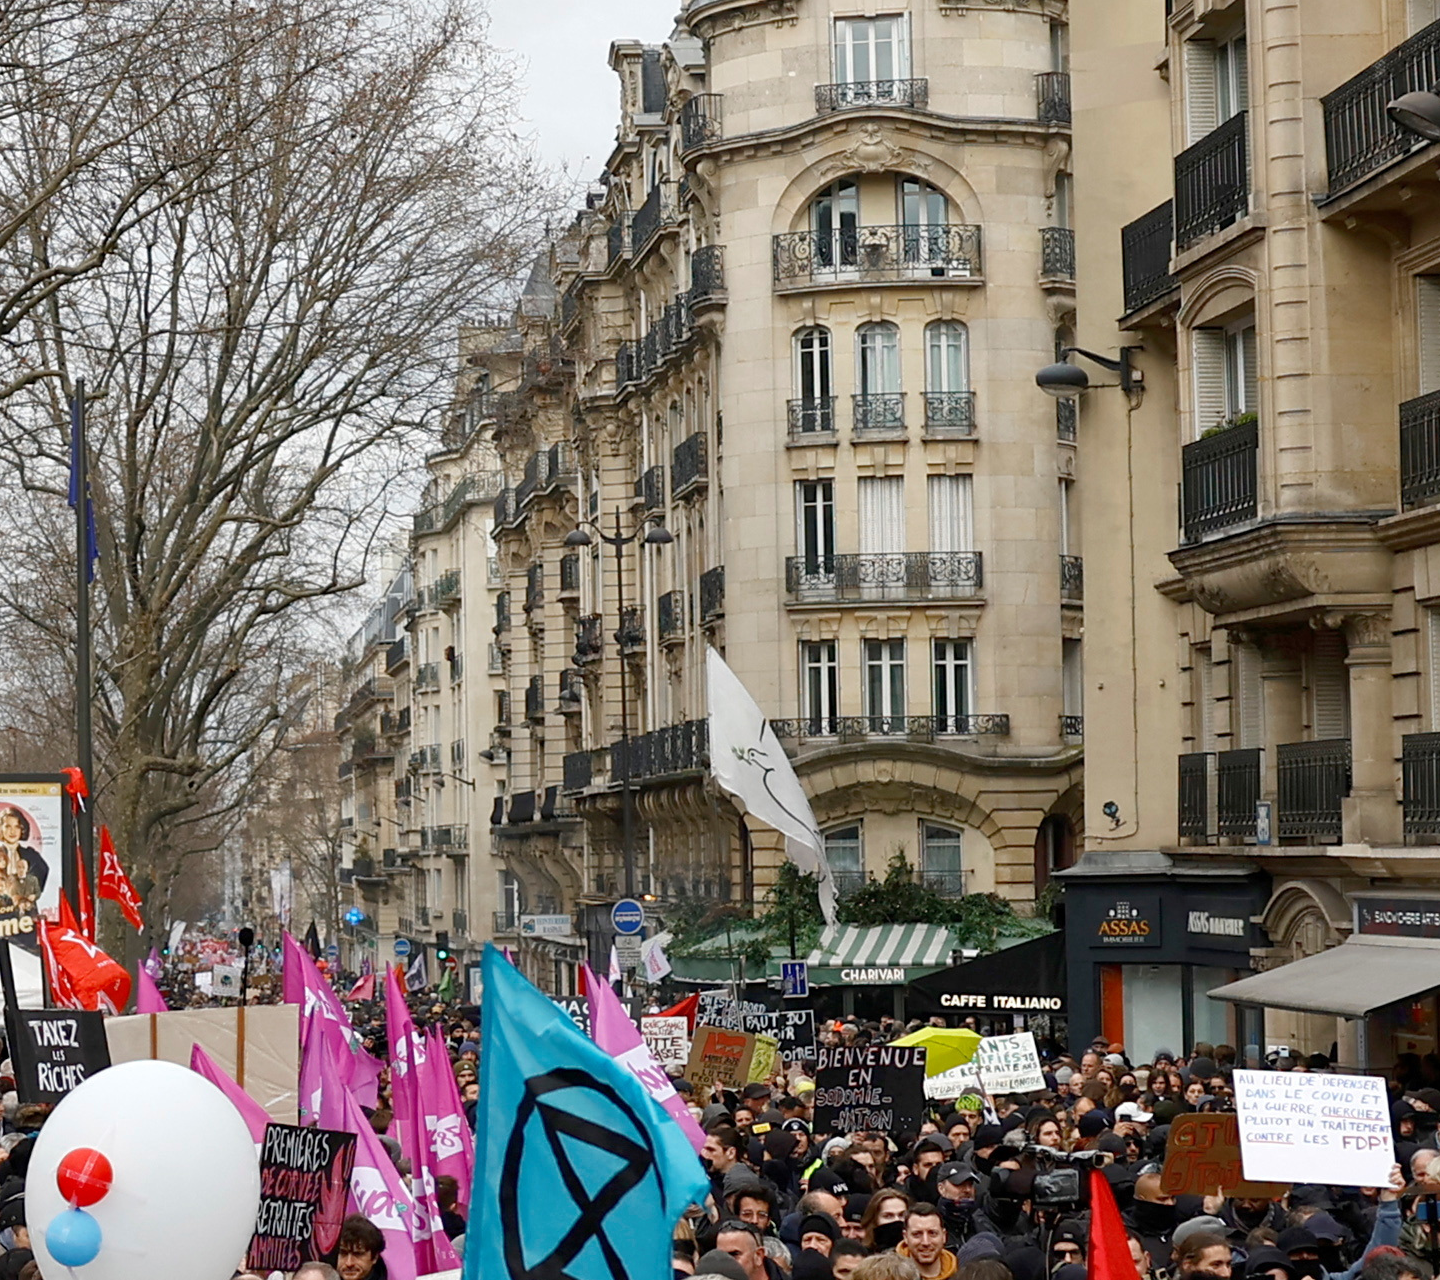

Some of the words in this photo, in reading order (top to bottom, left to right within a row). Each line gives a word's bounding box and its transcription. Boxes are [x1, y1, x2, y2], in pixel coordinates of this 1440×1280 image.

[1098, 920, 1150, 935] ASSAS
[841, 968, 905, 981] CHARIVARI
[940, 994, 986, 1007] CAFFE
[993, 996, 1062, 1010] ITALIANO
[746, 1013, 778, 1031] FAUT
[786, 1013, 806, 1025] DU
[28, 1020, 79, 1047] TAXEZ
[645, 1036, 684, 1050] UTTE
[52, 1050, 65, 1061] LES
[818, 1047, 925, 1070] BIENVENUE
[849, 1068, 872, 1086] EN
[1238, 1074, 1254, 1086] AU
[1263, 1075, 1292, 1086] LIEU
[1299, 1075, 1315, 1087] DE
[1246, 1088, 1276, 1099] DANS
[1284, 1089, 1303, 1100] LE
[1312, 1090, 1354, 1103] COVID
[1361, 1095, 1381, 1105] ET
[1242, 1101, 1258, 1110] LA
[1321, 1106, 1382, 1119] CHERCHEZ
[1298, 1118, 1314, 1128] UN
[1246, 1132, 1294, 1143] CONTRE
[1303, 1134, 1330, 1145] LES
[256, 1199, 315, 1241] RETRAITES
